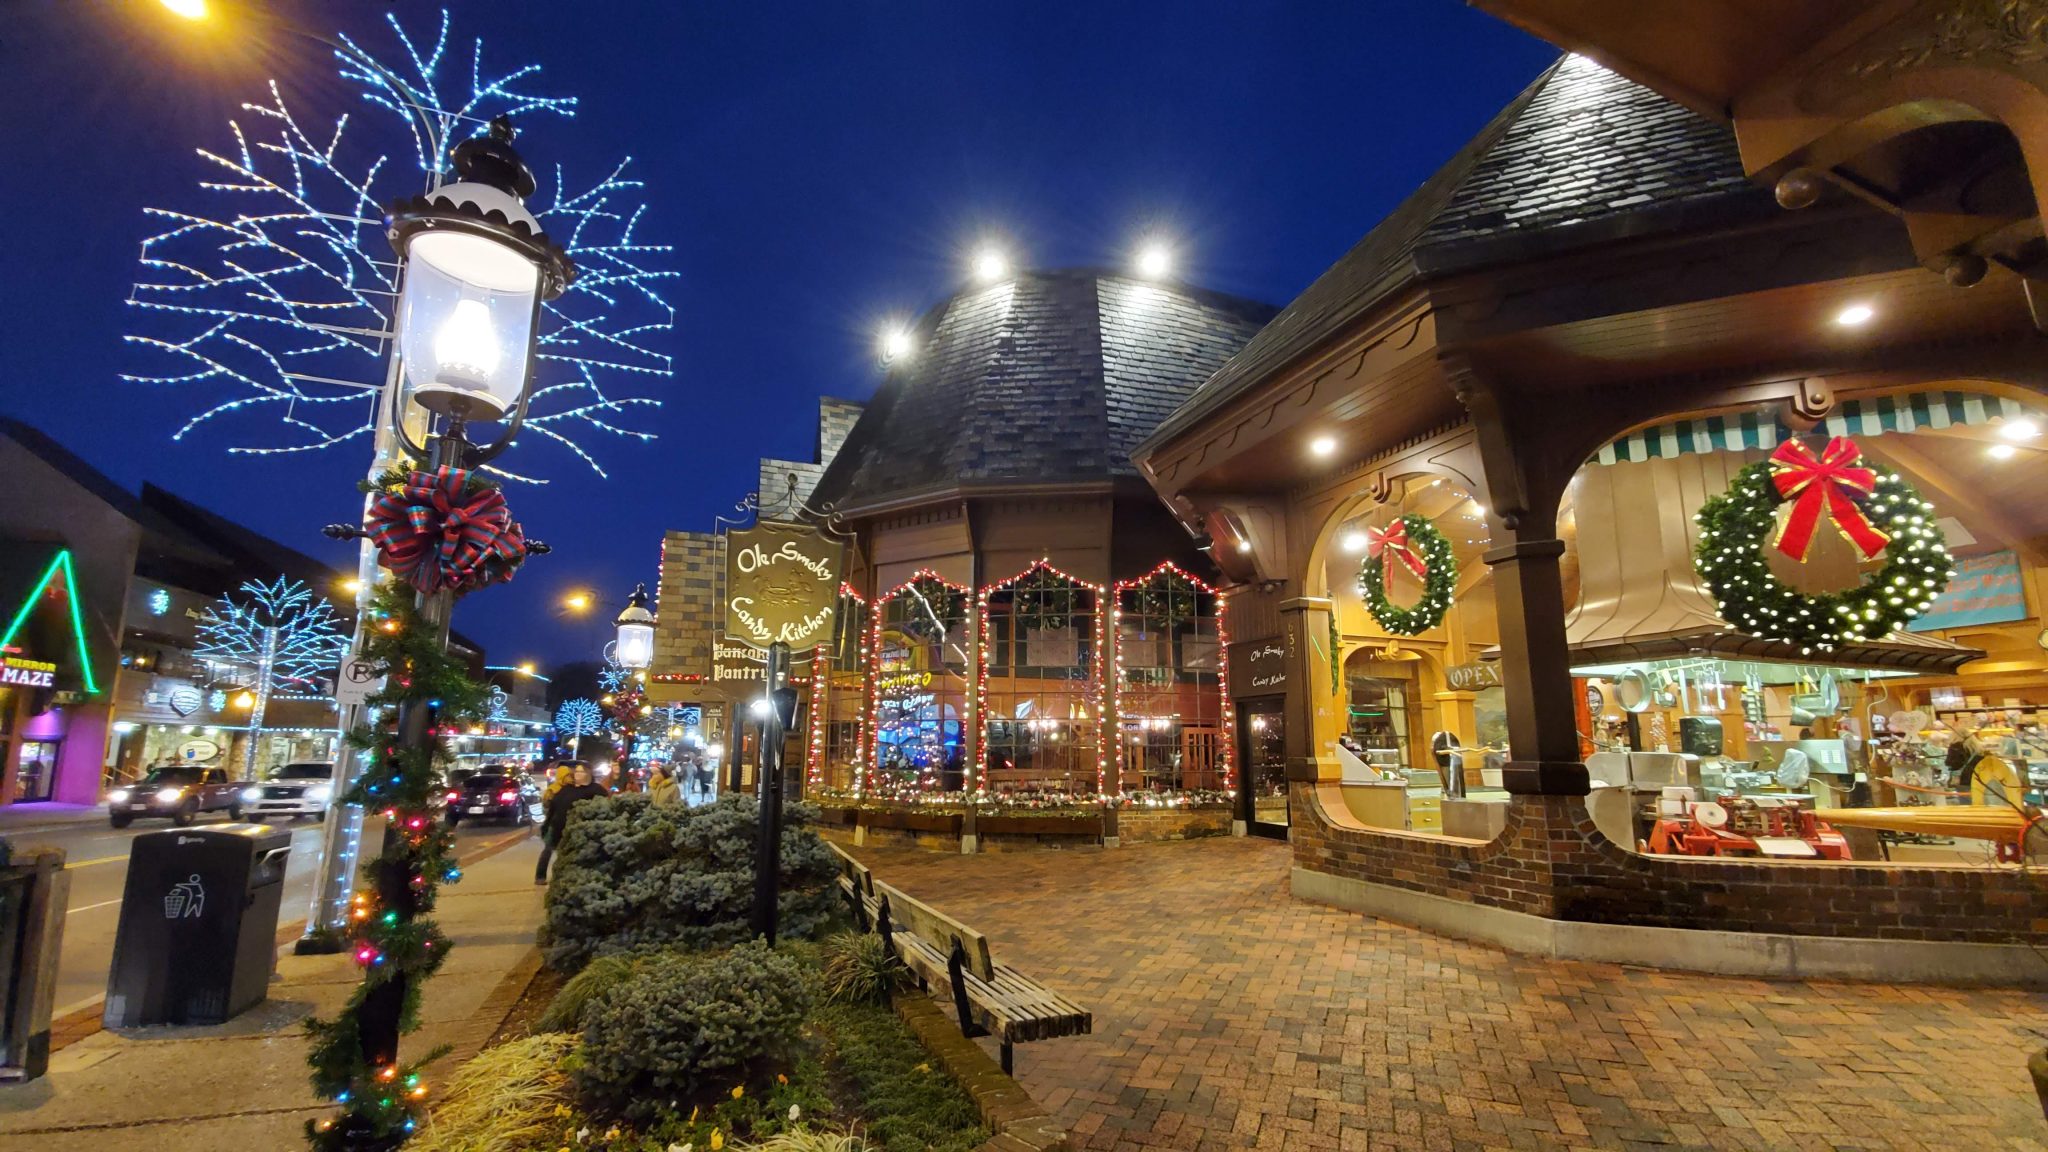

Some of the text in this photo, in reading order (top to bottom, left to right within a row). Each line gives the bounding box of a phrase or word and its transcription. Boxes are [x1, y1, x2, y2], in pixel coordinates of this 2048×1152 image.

[737, 541, 833, 581] Ole Smoky
[731, 596, 833, 642] Candy Kitchen
[713, 643, 768, 660] Pancak
[5, 657, 56, 672] MIRROR
[713, 664, 768, 682] Pantry
[2, 668, 54, 687] MAZE
[1450, 664, 1500, 688] OPEN
